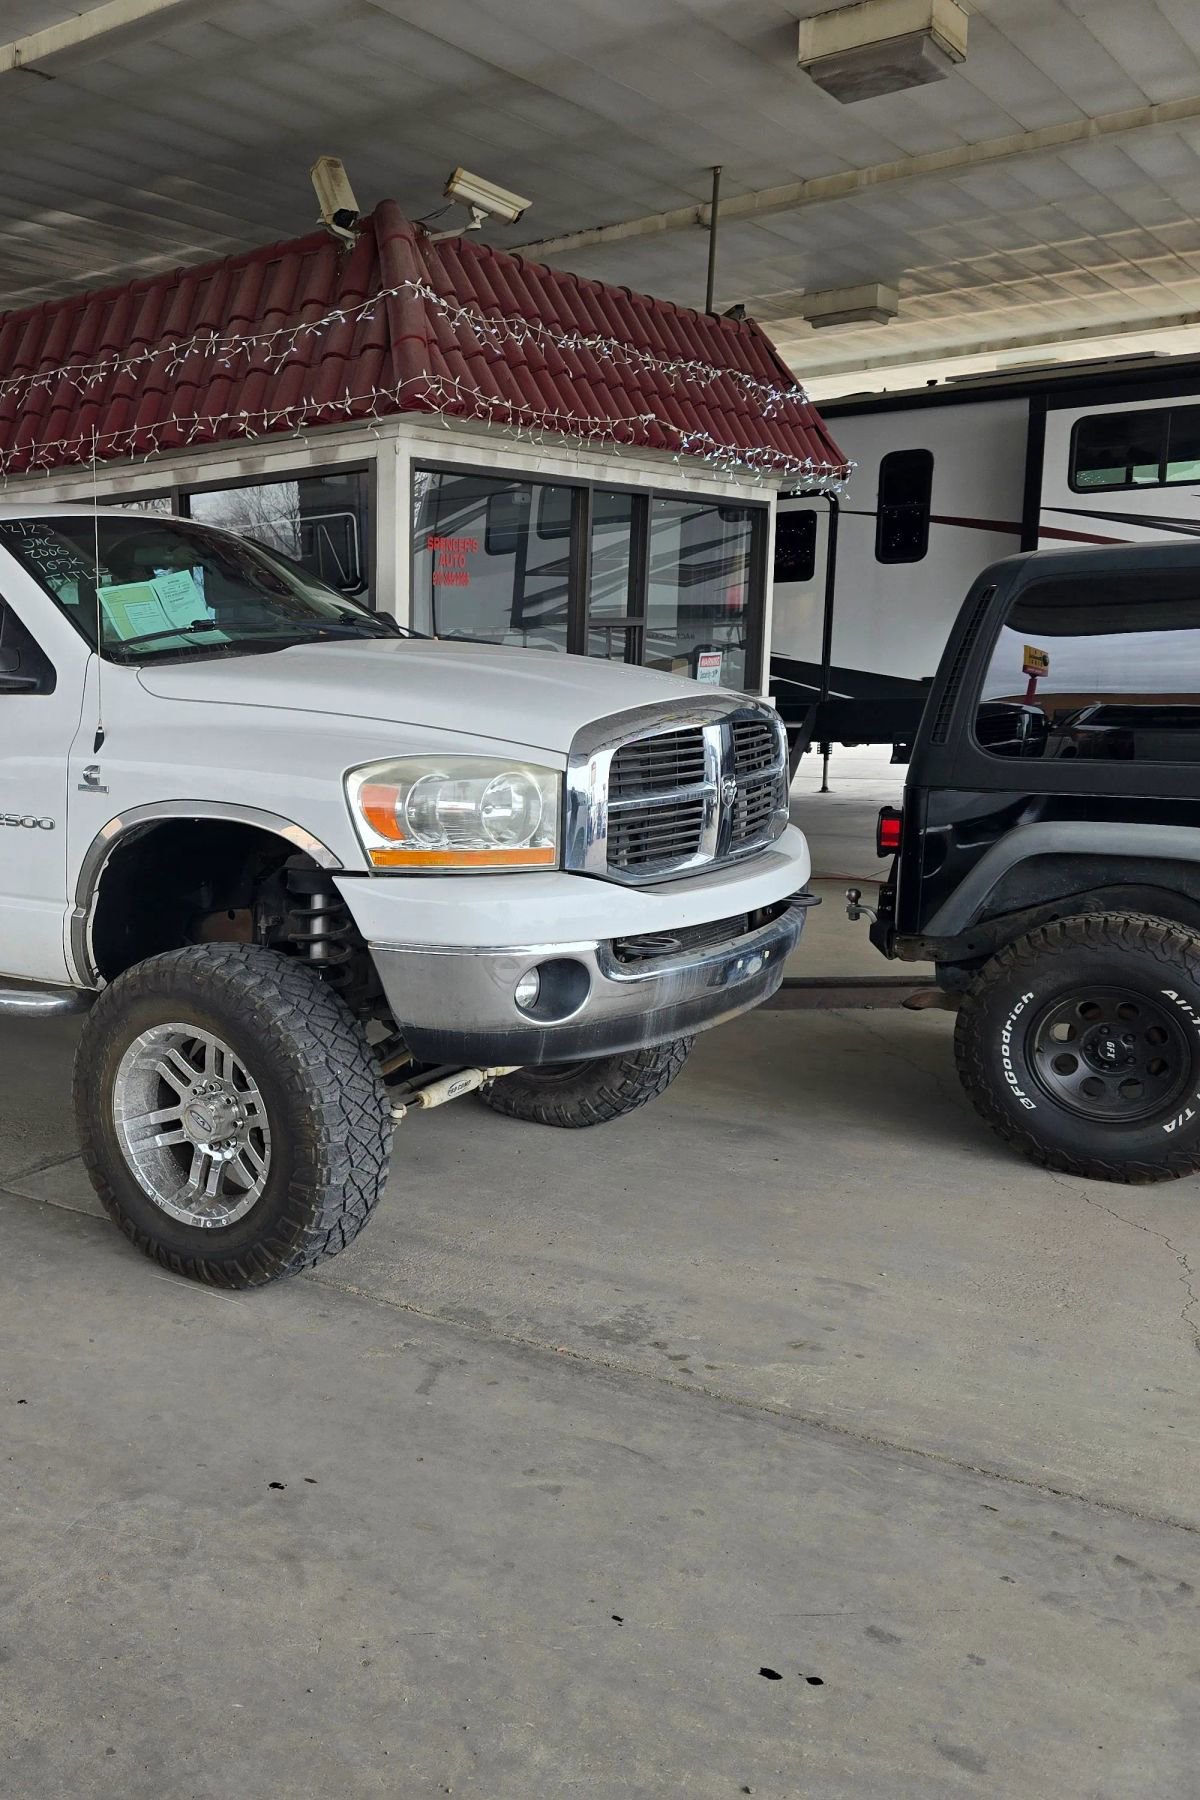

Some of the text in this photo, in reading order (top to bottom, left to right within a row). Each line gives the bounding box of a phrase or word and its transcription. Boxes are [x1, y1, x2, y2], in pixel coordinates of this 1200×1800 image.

[24, 546, 70, 559] 2006
[427, 536, 479, 553] SPENCER'S
[439, 553, 466, 568] AUTO
[1161, 989, 1200, 1038] All-T
[1001, 991, 1036, 1110] BFGoodrich
[1106, 1041, 1116, 1059] GFX
[1162, 1107, 1196, 1133] T/A
